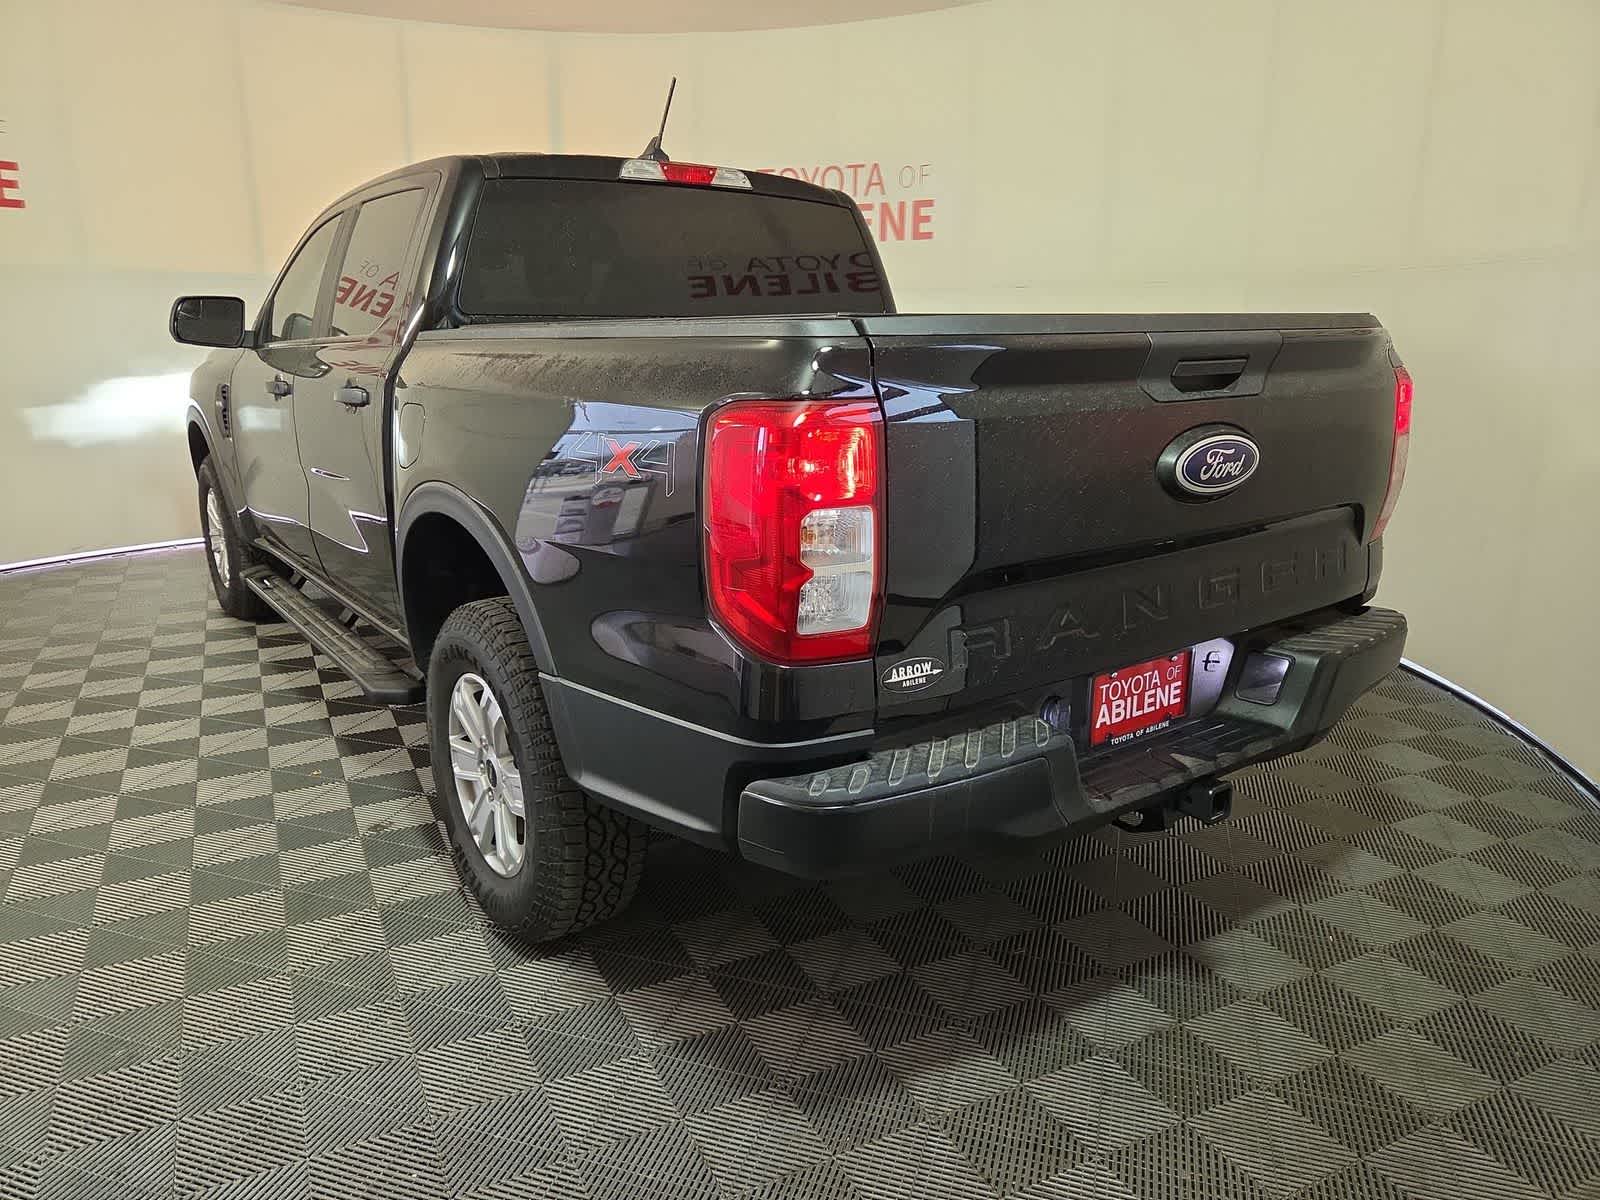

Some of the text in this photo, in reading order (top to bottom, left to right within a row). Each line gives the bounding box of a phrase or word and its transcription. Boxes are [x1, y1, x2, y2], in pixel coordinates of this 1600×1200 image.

[756, 162, 933, 197] YOTA OF
[1200, 448, 1246, 480] Ford
[891, 661, 932, 680] ARROW
[903, 677, 926, 687] ABILENE
[1100, 664, 1182, 702] TOYOTA OF
[1095, 681, 1182, 728] ABILENE
[1111, 720, 1170, 745] TOYOTA OF ABILENE
